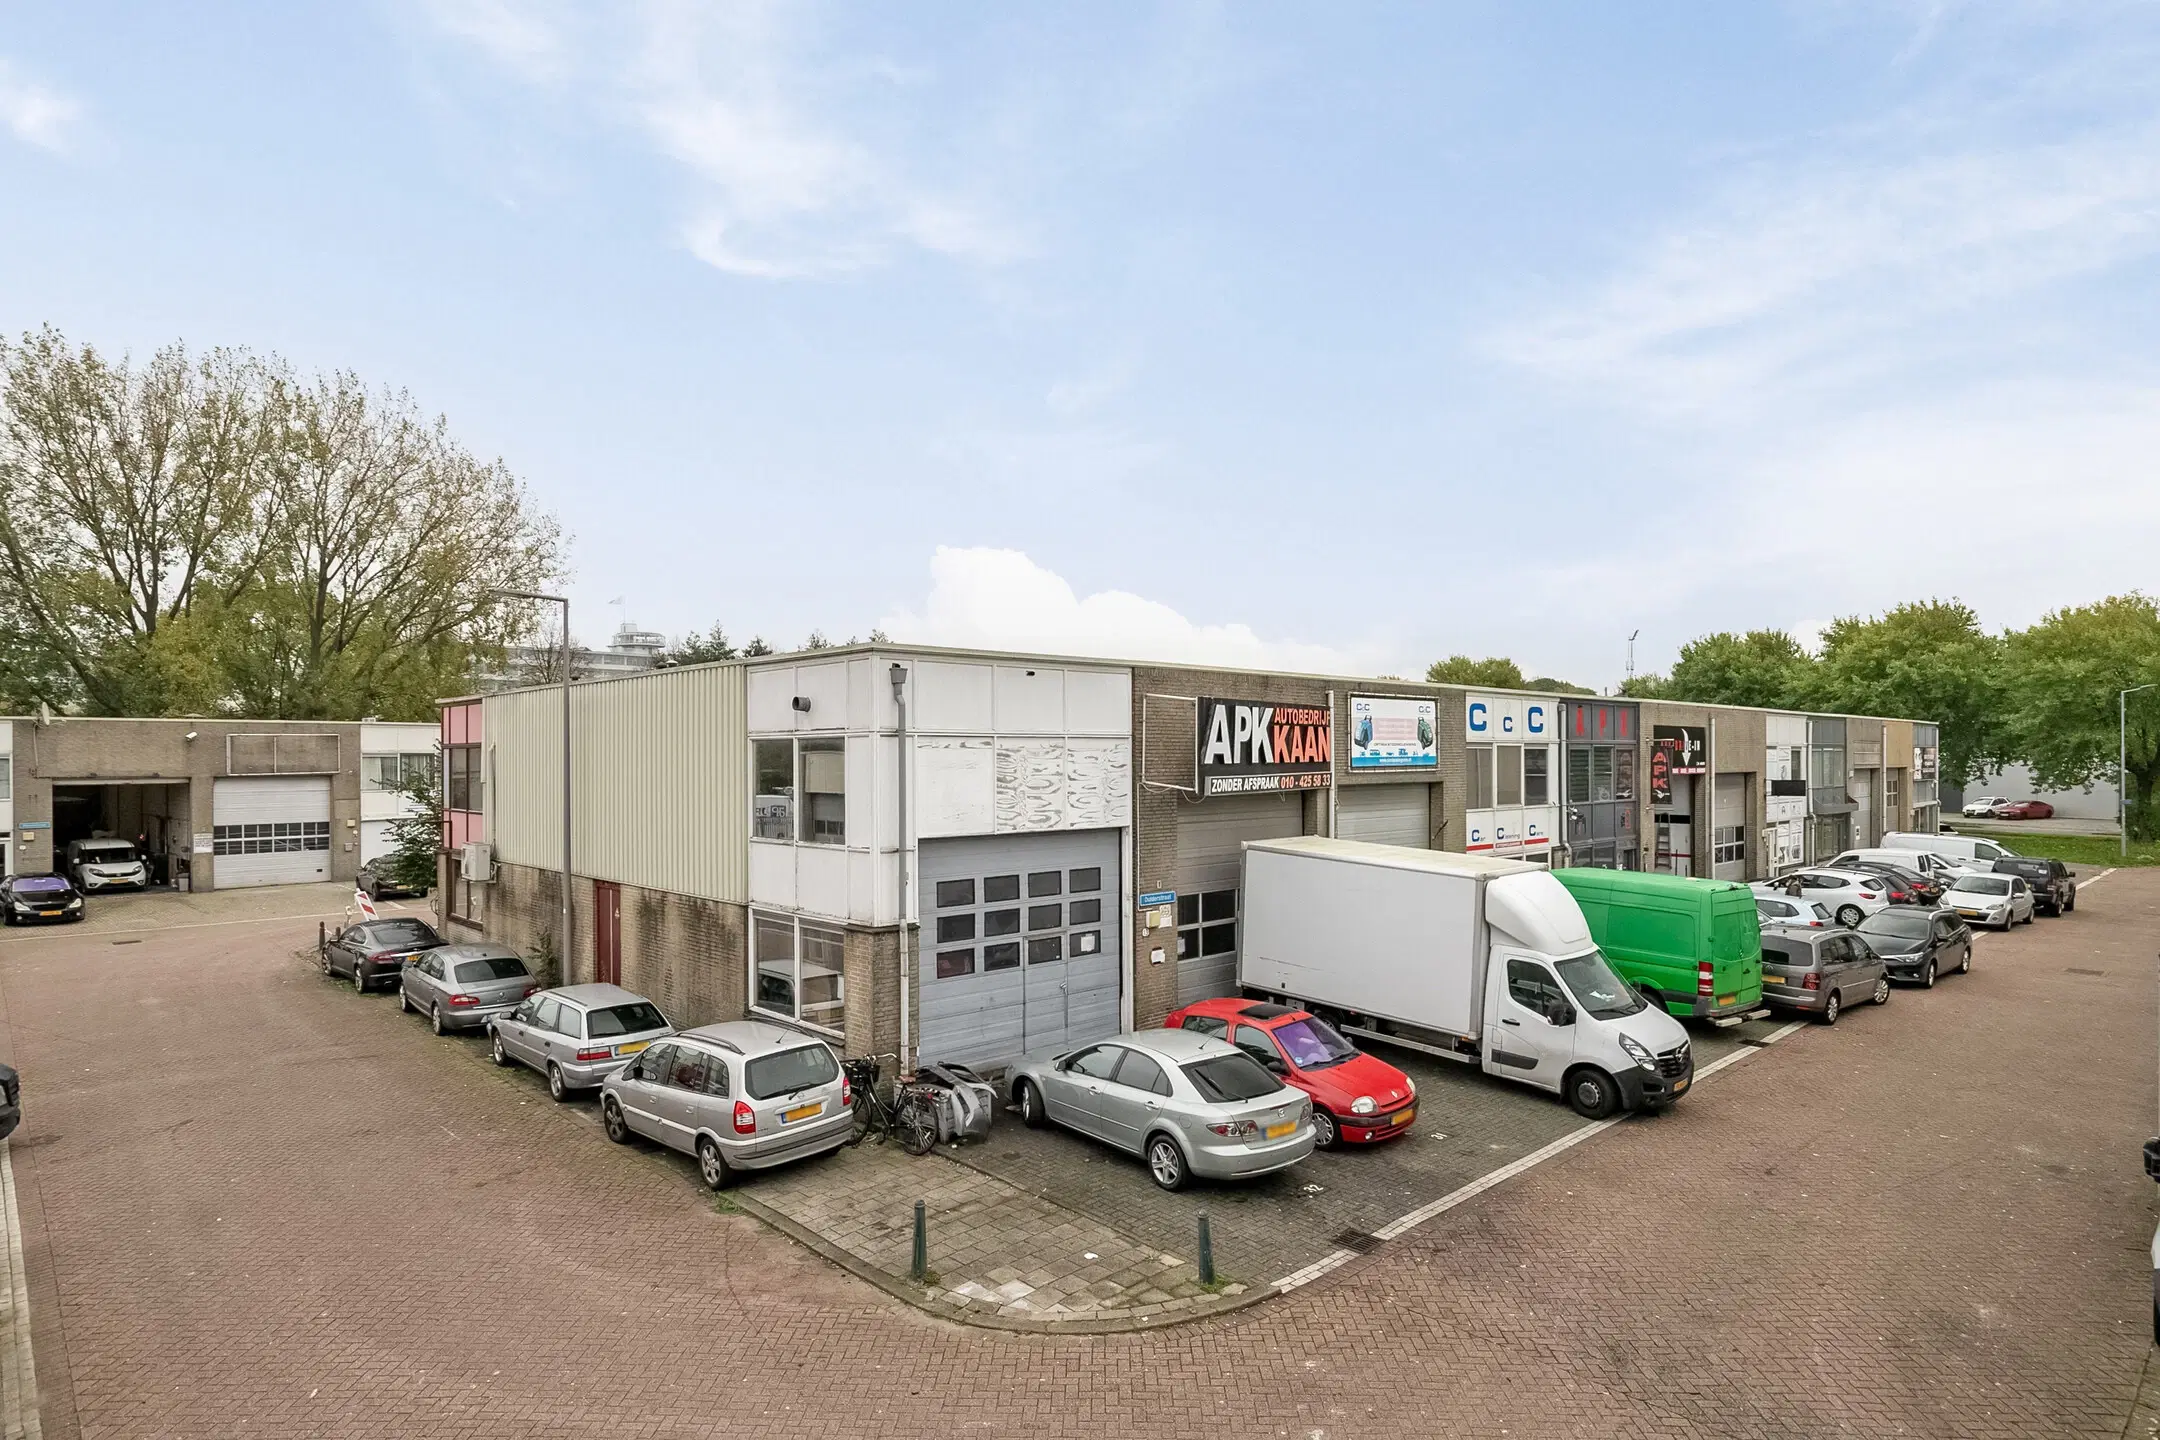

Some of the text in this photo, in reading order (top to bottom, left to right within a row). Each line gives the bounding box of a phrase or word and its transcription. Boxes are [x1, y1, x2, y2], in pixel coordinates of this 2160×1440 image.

[1204, 704, 1275, 764] APK
[1274, 725, 1331, 764] KAAN
[1211, 778, 1243, 793] ZONDER
[1243, 775, 1280, 790] AFSPRAAK
[1280, 776, 1295, 789] 010
[1299, 775, 1312, 788] 425
[1313, 775, 1321, 786] 58
[1322, 774, 1331, 786] 33
[1652, 751, 1668, 789] APK
[1430, 1132, 1448, 1140] 31
[1303, 1184, 1324, 1193] 32
